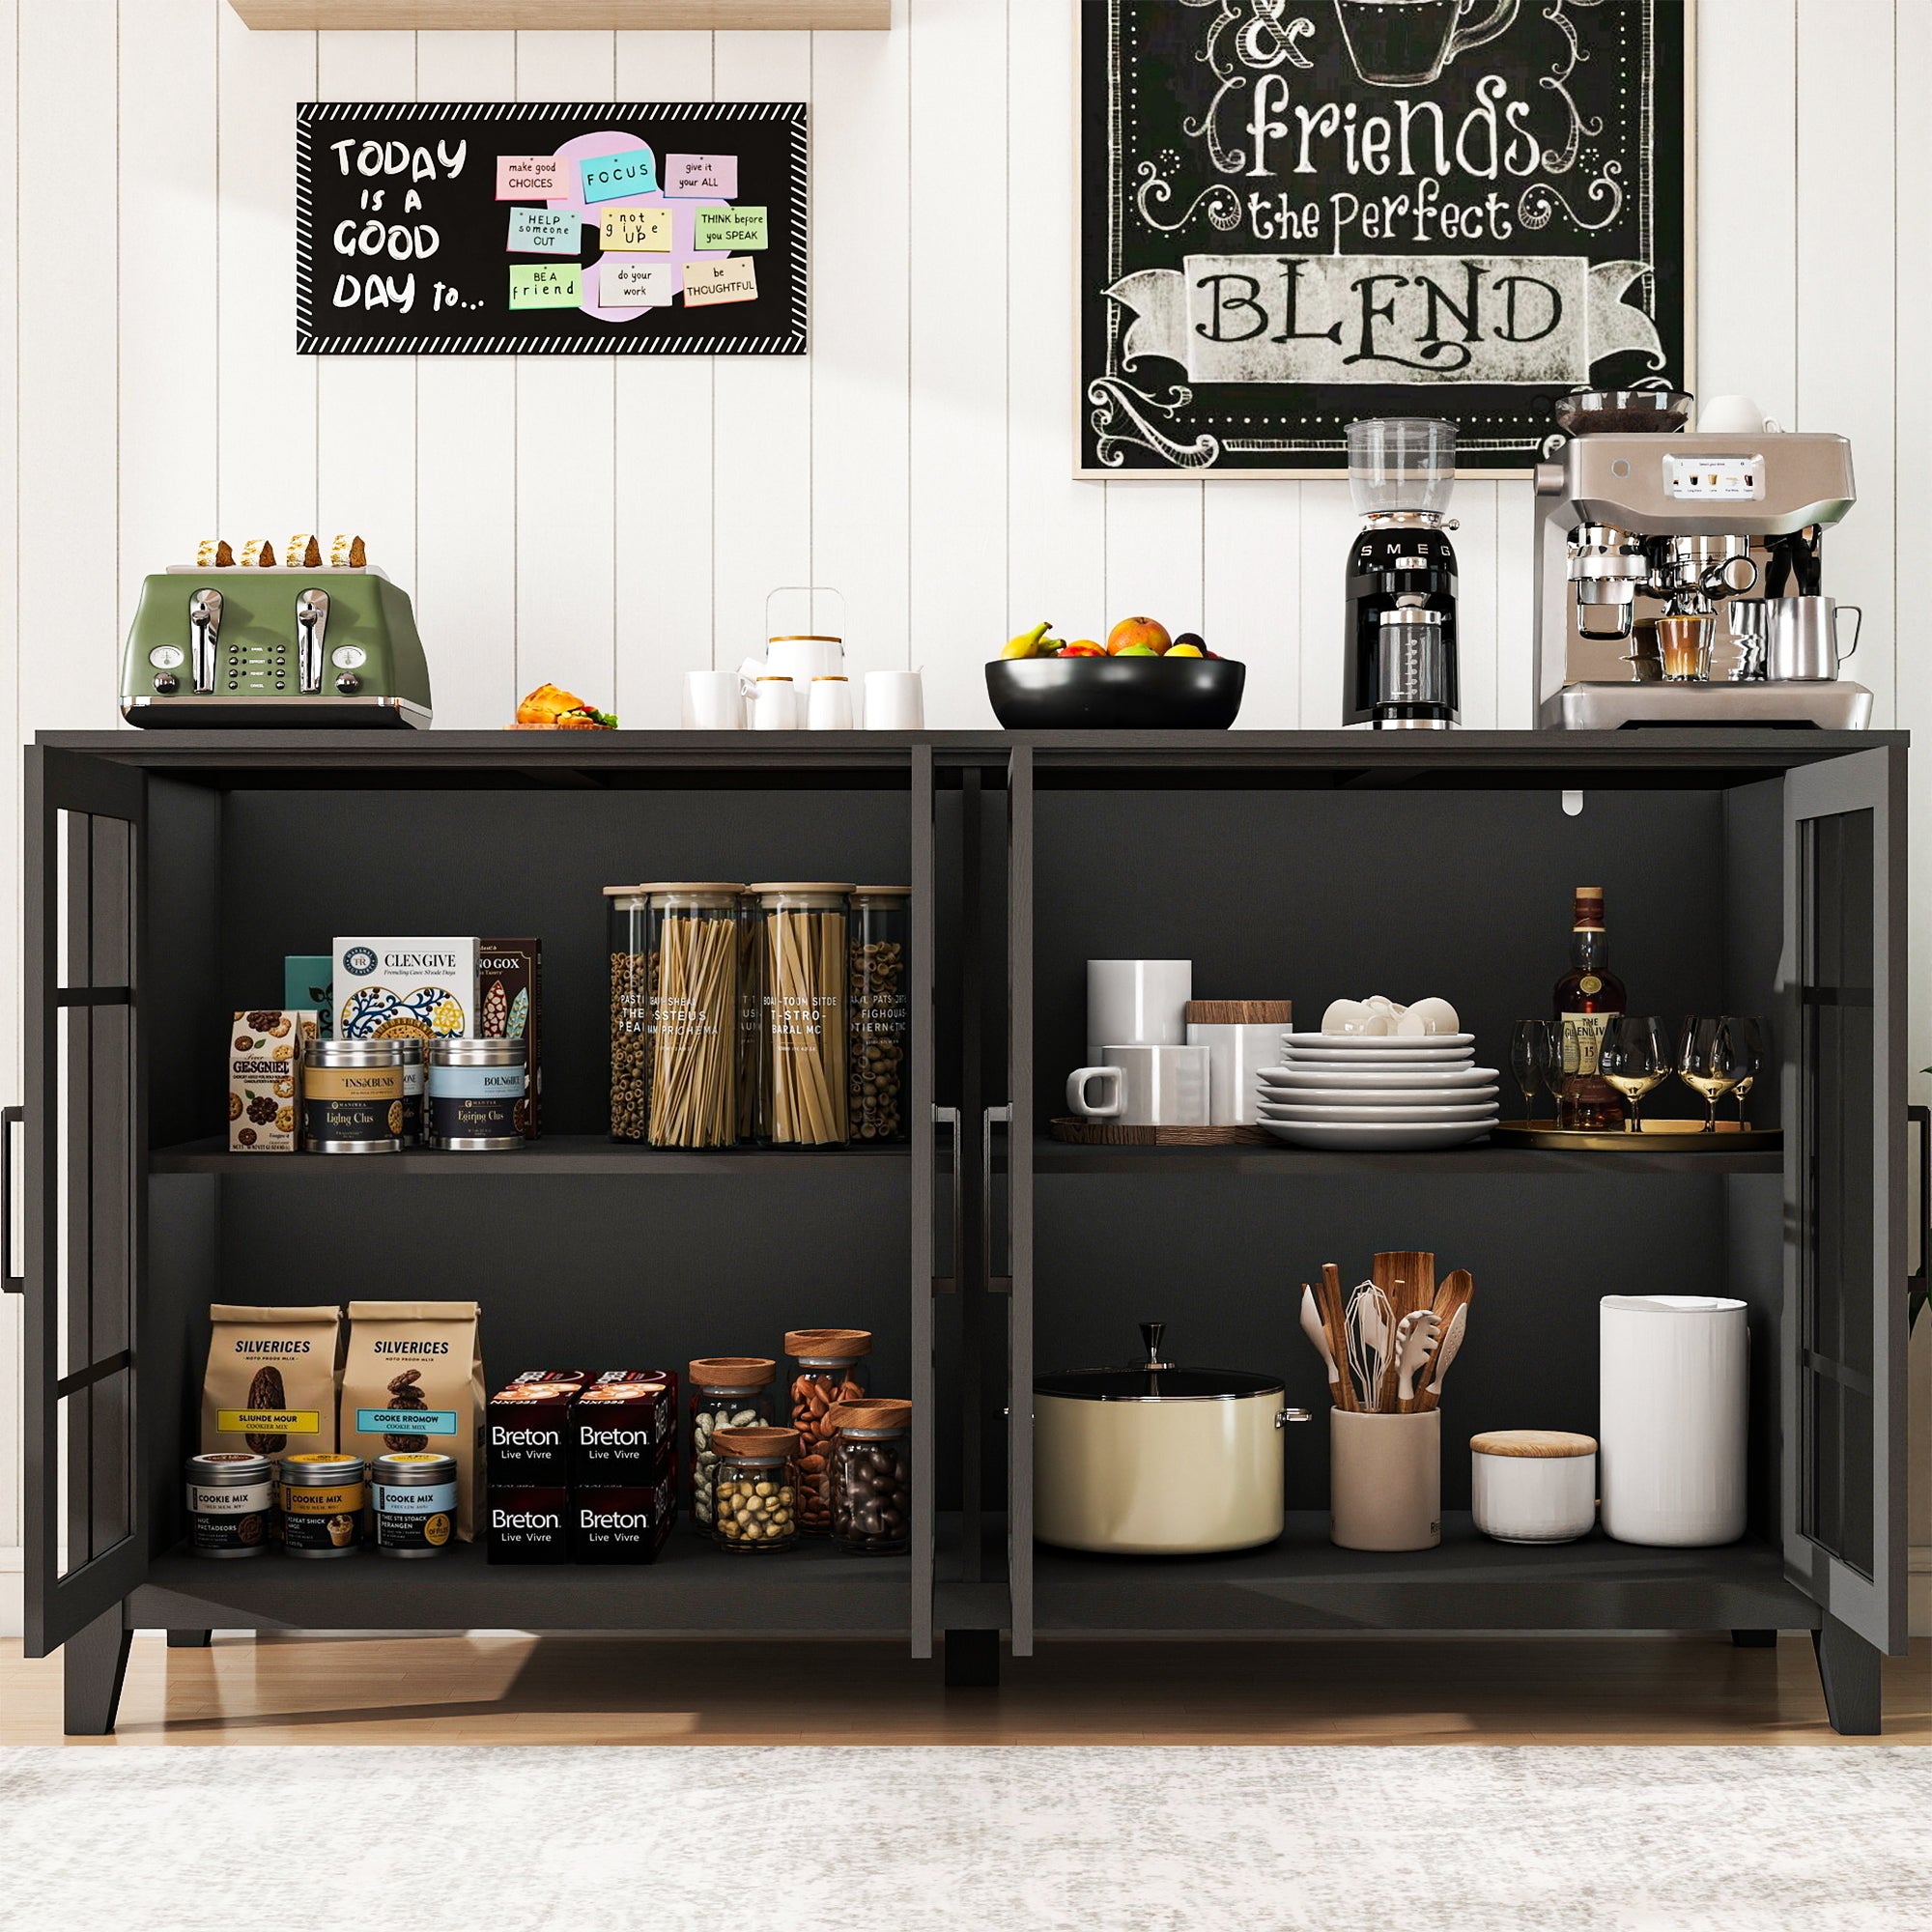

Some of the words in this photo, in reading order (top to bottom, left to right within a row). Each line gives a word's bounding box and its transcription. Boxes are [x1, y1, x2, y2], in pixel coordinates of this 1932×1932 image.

[1245, 73, 1542, 180] friends
[330, 138, 467, 184] TODAY
[509, 162, 532, 172] make
[535, 162, 556, 175] good
[686, 162, 702, 174] give
[704, 162, 713, 172] it
[586, 164, 648, 185] FOCUS
[508, 179, 554, 188] CHOICES
[679, 179, 698, 188] your
[701, 178, 719, 186] ALL
[360, 188, 385, 212] IS
[404, 188, 422, 213] A
[528, 215, 560, 225] HELP
[619, 213, 645, 222] not
[701, 213, 731, 223] THINK
[734, 213, 763, 226] before
[1248, 190, 1320, 240] the
[519, 225, 569, 235] someone
[606, 223, 658, 238] give
[333, 219, 440, 261] GOOD
[625, 232, 646, 243] UP
[706, 233, 723, 243] you
[725, 231, 758, 241] SPEAK
[533, 272, 547, 282] BE
[550, 272, 557, 281] A
[618, 270, 629, 280] do
[631, 272, 652, 282] your
[713, 268, 724, 277] be
[332, 272, 415, 314] DAY
[513, 281, 574, 299] friend
[624, 287, 646, 296] work
[686, 281, 754, 296] THOUGHTFUL
[1195, 258, 1563, 371] BLEND
[1361, 543, 1451, 556] SMEG
[384, 953, 456, 967] CLENGIVE
[493, 958, 520, 969] GOX
[622, 1008, 644, 1018] THE
[235, 1340, 310, 1352] SILVERICES
[374, 1341, 449, 1354] SILVERICES
[492, 1426, 559, 1445] Breton
[581, 1426, 647, 1445] Breton
[501, 1450, 522, 1459] Live
[526, 1450, 552, 1459] Vivre
[589, 1450, 610, 1459] Live
[614, 1450, 639, 1459] Vivre
[198, 1494, 230, 1503] COOKIE
[292, 1494, 324, 1503] COOKIE
[326, 1494, 342, 1503] MIX
[385, 1494, 414, 1503] COOKE
[492, 1509, 559, 1528] Breton
[581, 1509, 647, 1528] Breton
[501, 1533, 522, 1542] Live
[526, 1533, 552, 1542] Vivre
[589, 1533, 610, 1542] Live
[614, 1533, 639, 1542] Vivre
